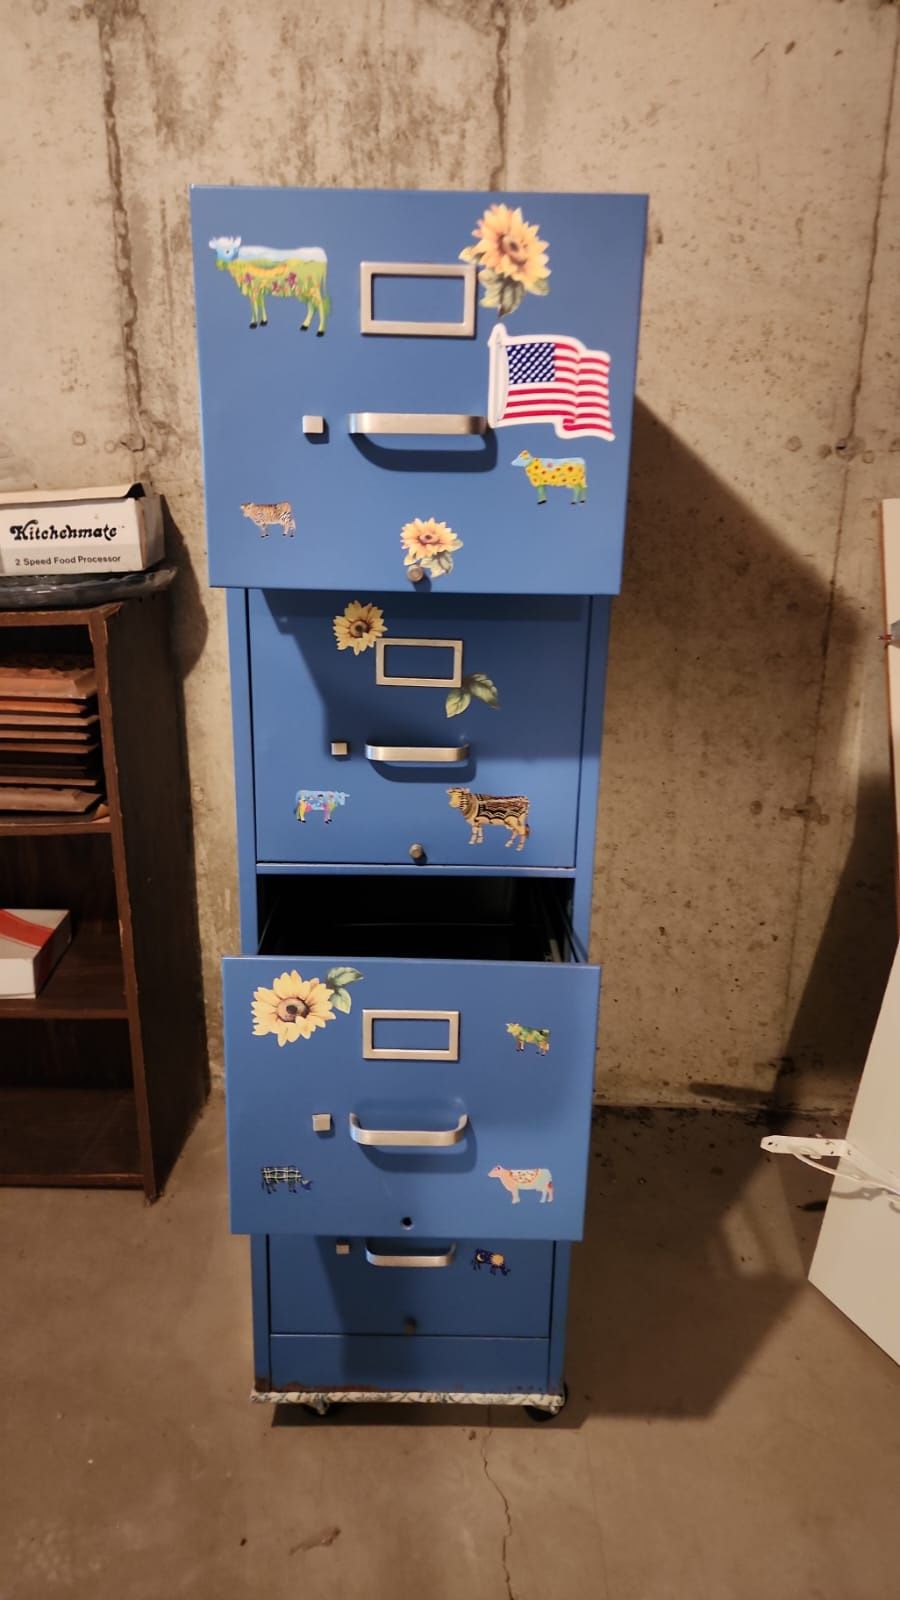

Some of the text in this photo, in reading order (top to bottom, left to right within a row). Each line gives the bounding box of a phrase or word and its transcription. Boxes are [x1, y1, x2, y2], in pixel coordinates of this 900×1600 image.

[10, 519, 117, 541] Kitchenmate
[15, 555, 121, 567] 2 Speed Food Processor
